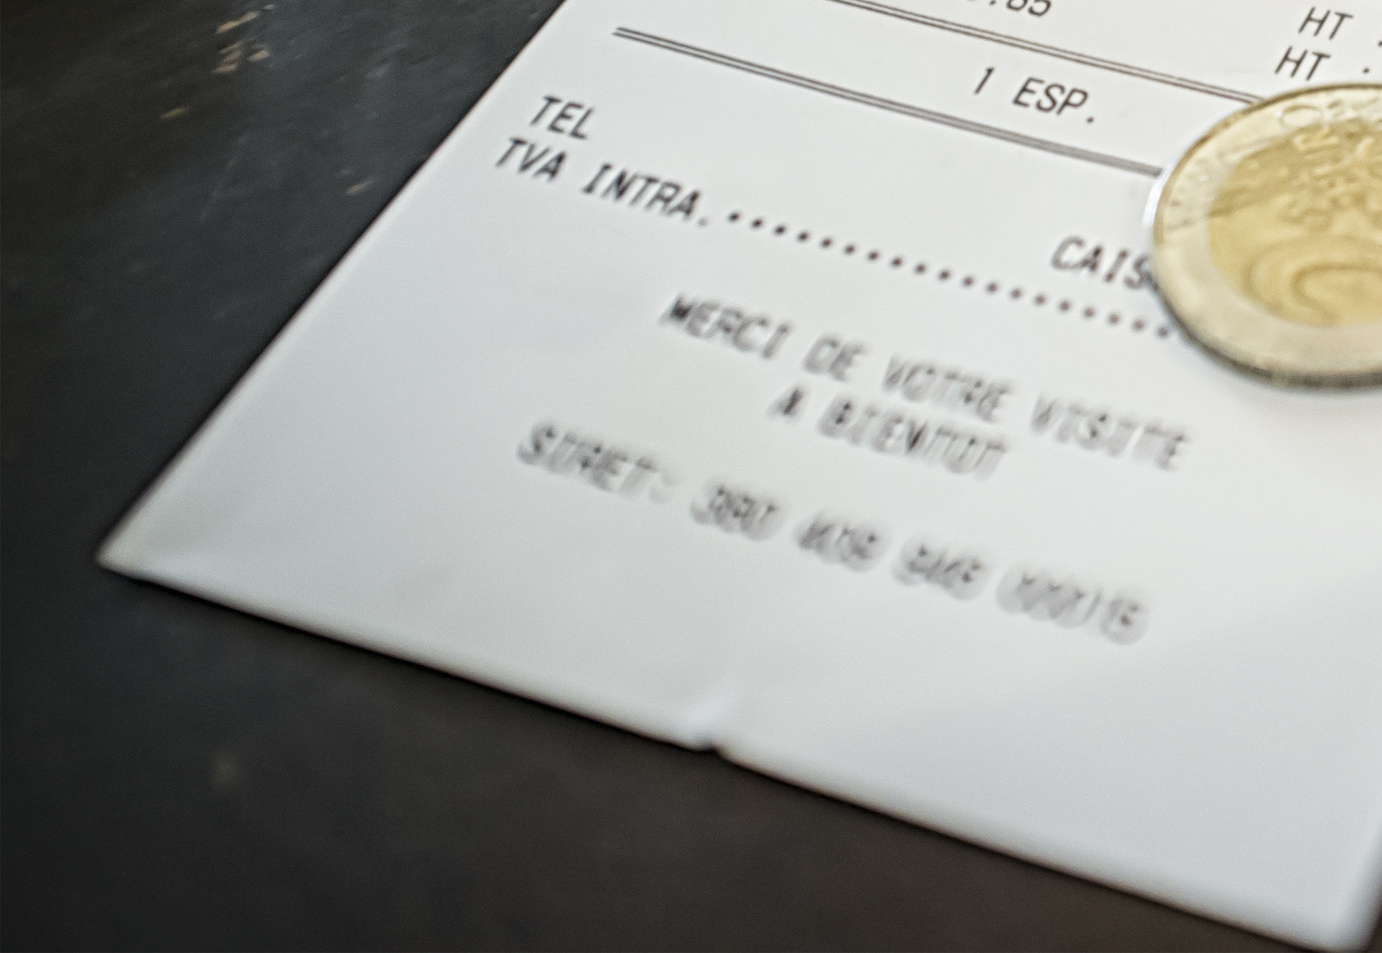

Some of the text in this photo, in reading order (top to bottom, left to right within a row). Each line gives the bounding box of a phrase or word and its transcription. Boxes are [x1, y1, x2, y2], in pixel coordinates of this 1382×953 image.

[1298, 7, 1354, 40] HT
[1275, 46, 1331, 81] HT
[528, 95, 596, 140] TEL
[1013, 77, 1095, 123] ESP.
[495, 138, 562, 182] TVA
[1051, 235, 1153, 290] CAIS
[659, 293, 1191, 472] MERCI DE VOTRE VISITE
[768, 385, 1010, 481] A BIENTOT
